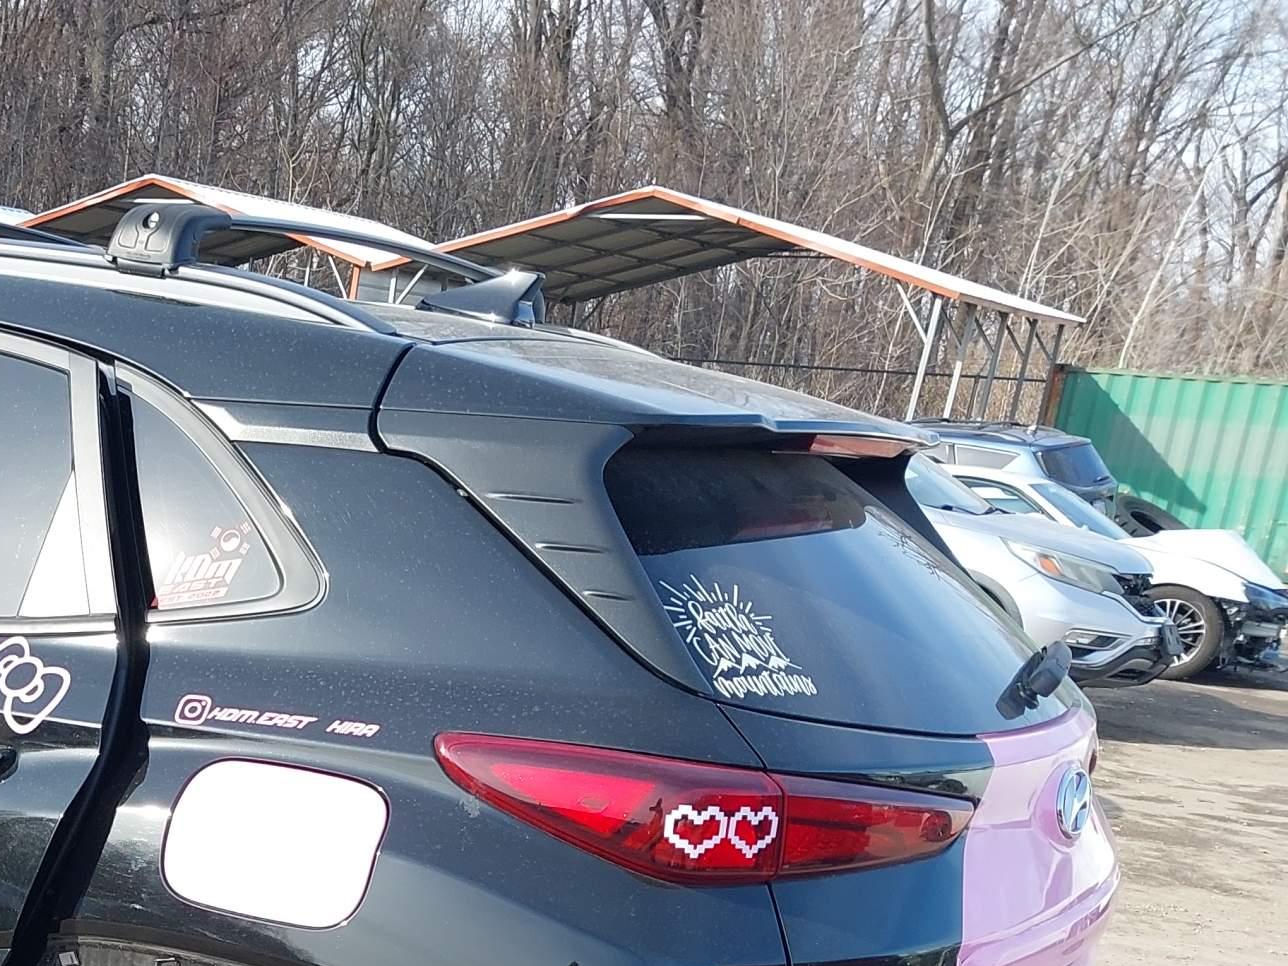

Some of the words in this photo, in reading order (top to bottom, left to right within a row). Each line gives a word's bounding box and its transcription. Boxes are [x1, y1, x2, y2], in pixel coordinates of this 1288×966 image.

[693, 633, 741, 666] CAN
[732, 631, 791, 663] MOVE
[713, 671, 817, 698] mountains
